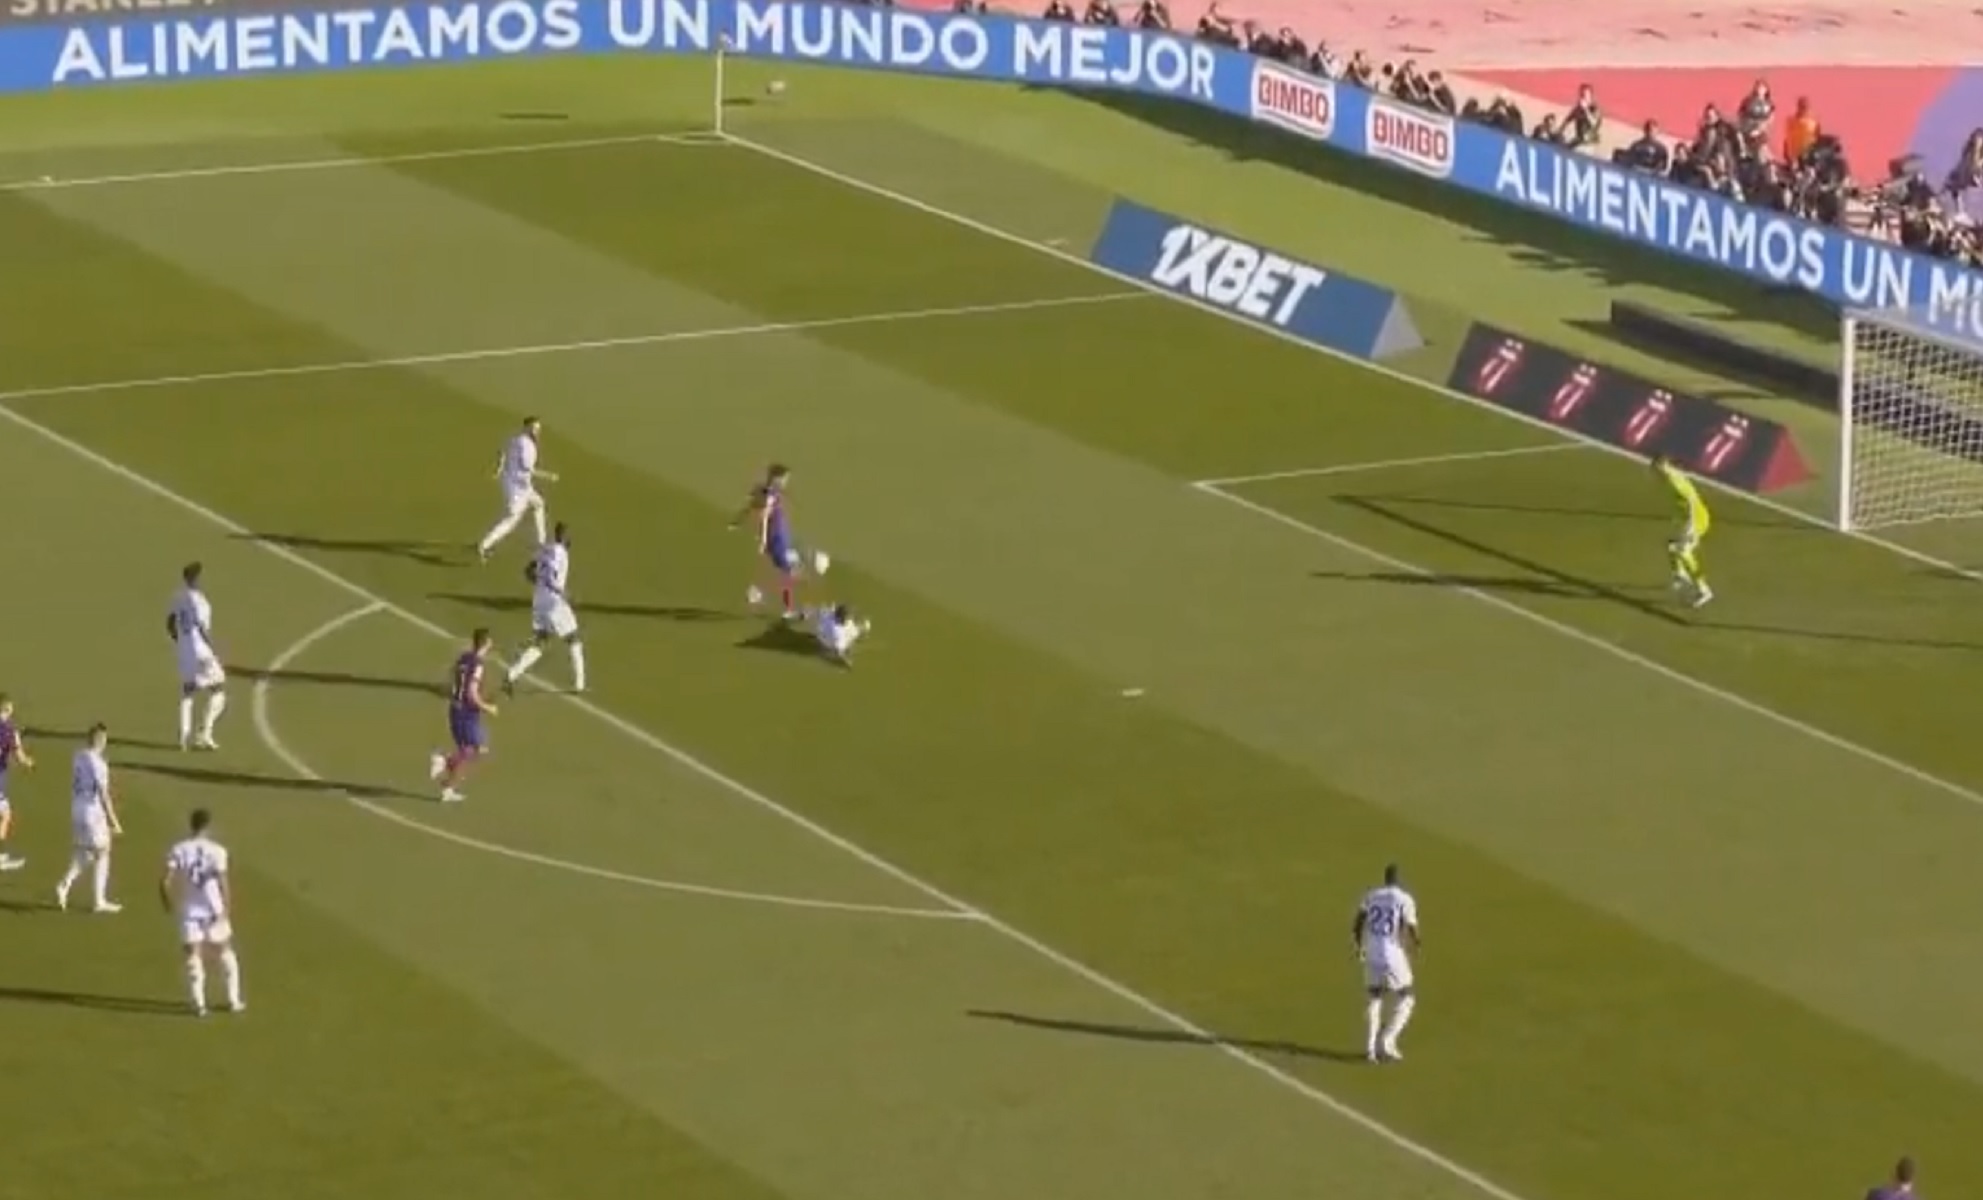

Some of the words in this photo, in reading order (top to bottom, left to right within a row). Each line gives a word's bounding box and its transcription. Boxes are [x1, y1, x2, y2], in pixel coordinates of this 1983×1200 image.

[53, 0, 581, 82] ALIMENTAMOS
[608, 0, 709, 48] UN
[736, 1, 989, 70] MUNDO
[1014, 22, 1216, 99] MEJOR
[1258, 73, 1330, 125] BIMBO
[1373, 111, 1448, 161] BIMBO
[1496, 138, 1825, 289] ALIMENTAMOS
[1842, 239, 1913, 308] UN
[1152, 224, 1327, 326] 1XBET
